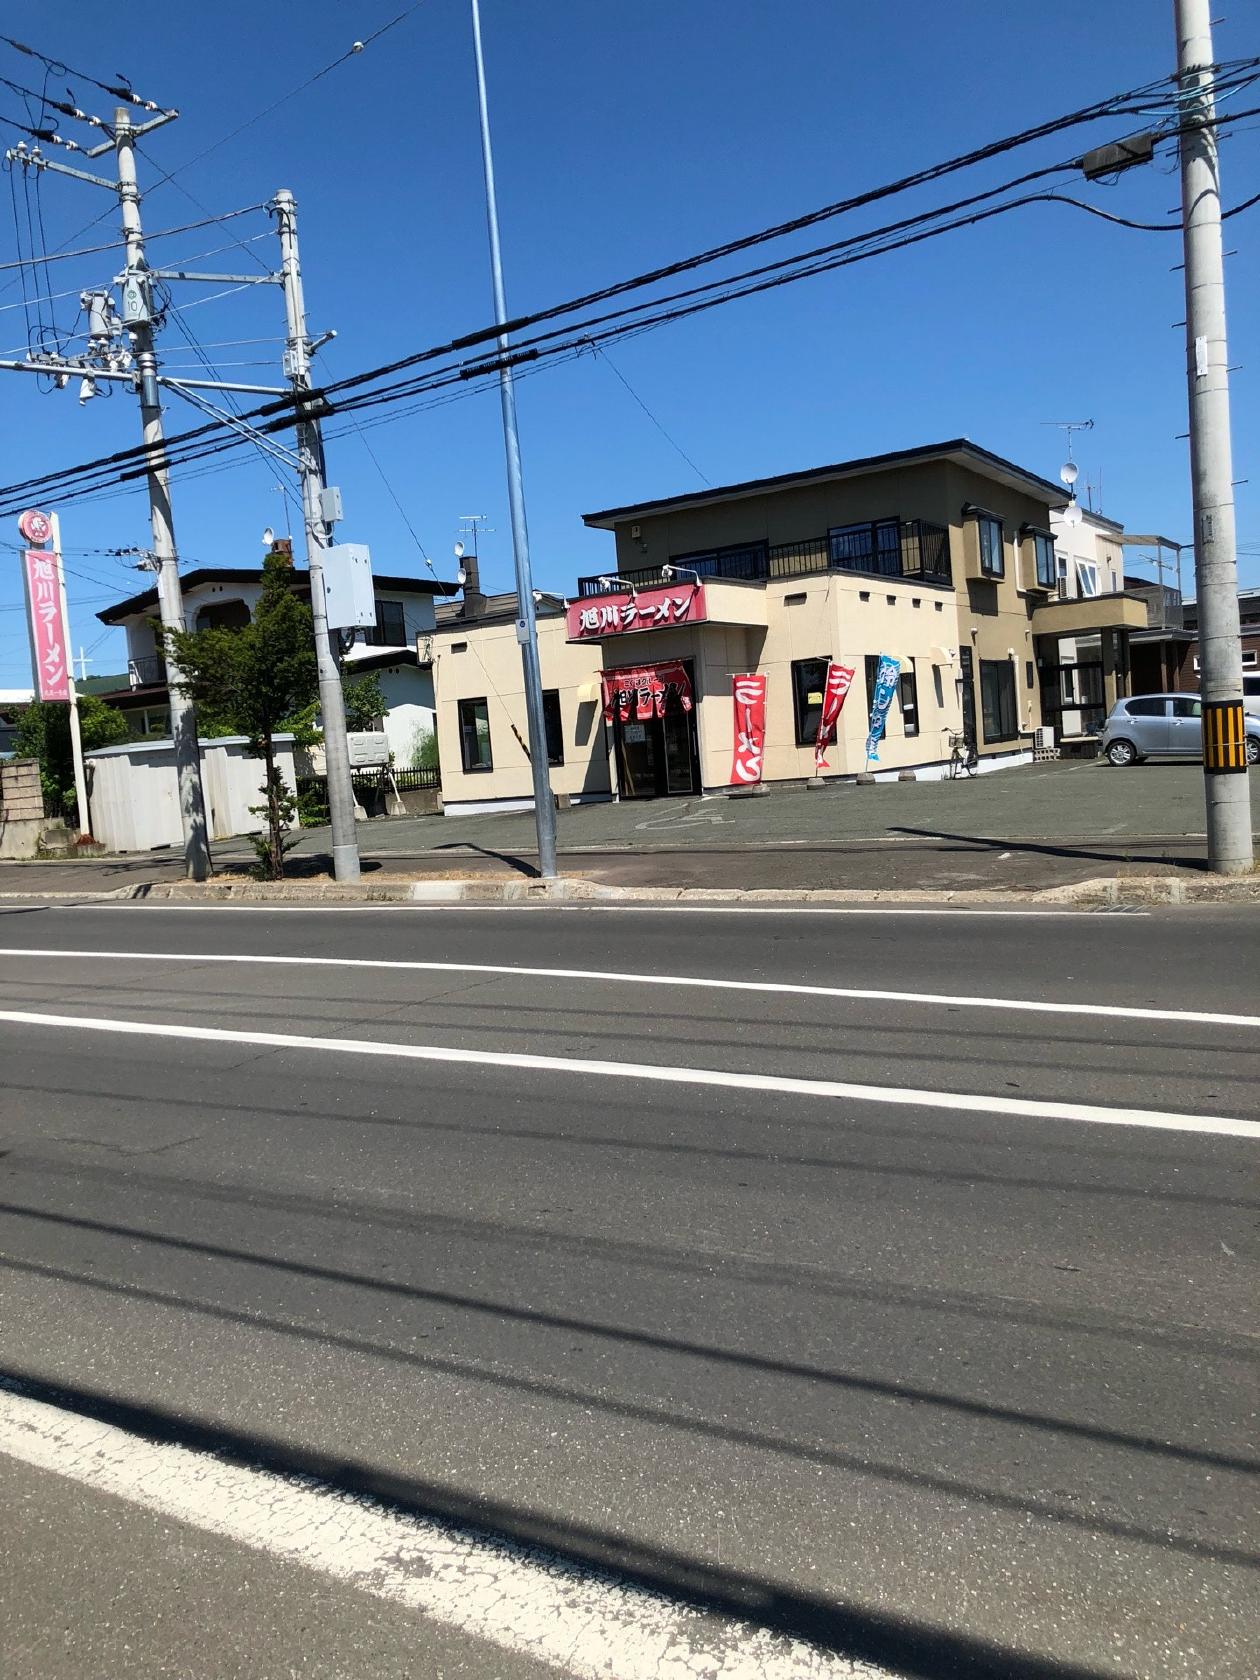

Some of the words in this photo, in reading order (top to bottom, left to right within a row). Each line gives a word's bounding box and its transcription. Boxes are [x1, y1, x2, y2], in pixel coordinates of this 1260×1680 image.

[33, 557, 64, 686] 旭川ラーメン
[579, 596, 691, 632] 旭川ラーメン
